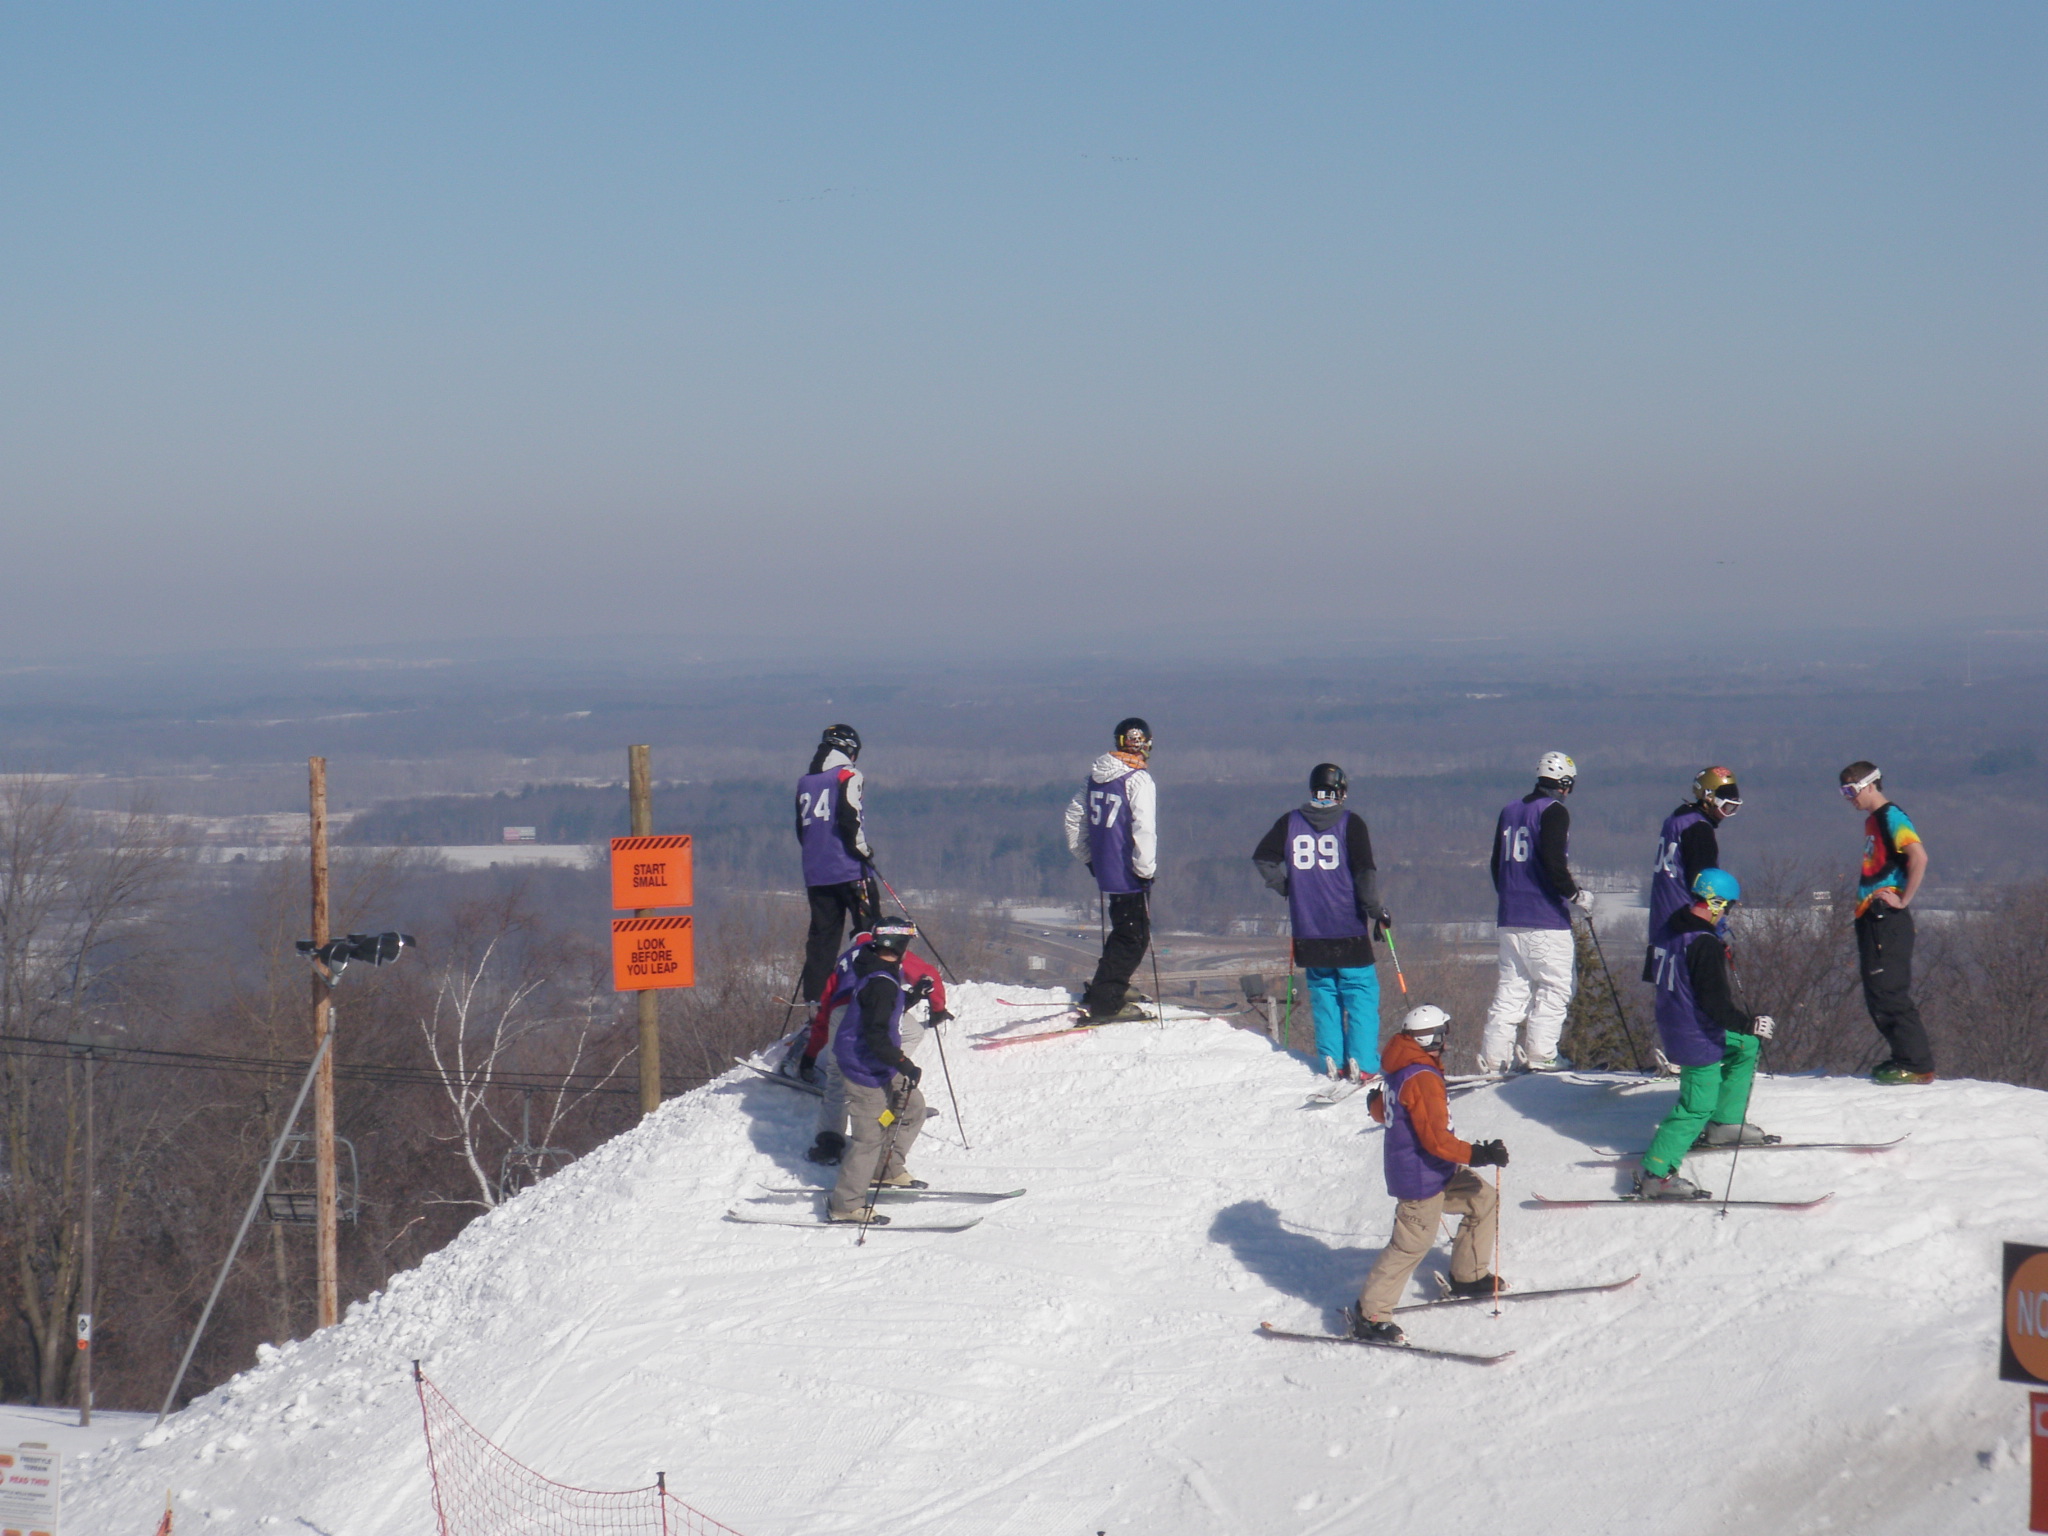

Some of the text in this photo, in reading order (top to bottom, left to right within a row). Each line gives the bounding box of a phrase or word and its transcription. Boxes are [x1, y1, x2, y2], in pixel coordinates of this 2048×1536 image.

[799, 788, 830, 827] 24
[1090, 790, 1122, 828] 57
[1293, 834, 1340, 871] 89
[1503, 825, 1530, 862] 16
[633, 863, 667, 876] START
[633, 877, 668, 888] SMALL
[631, 950, 673, 963] BEFORE
[637, 938, 666, 950] LOOK
[627, 962, 678, 975] YOU LEAP
[1654, 946, 1676, 991] 71
